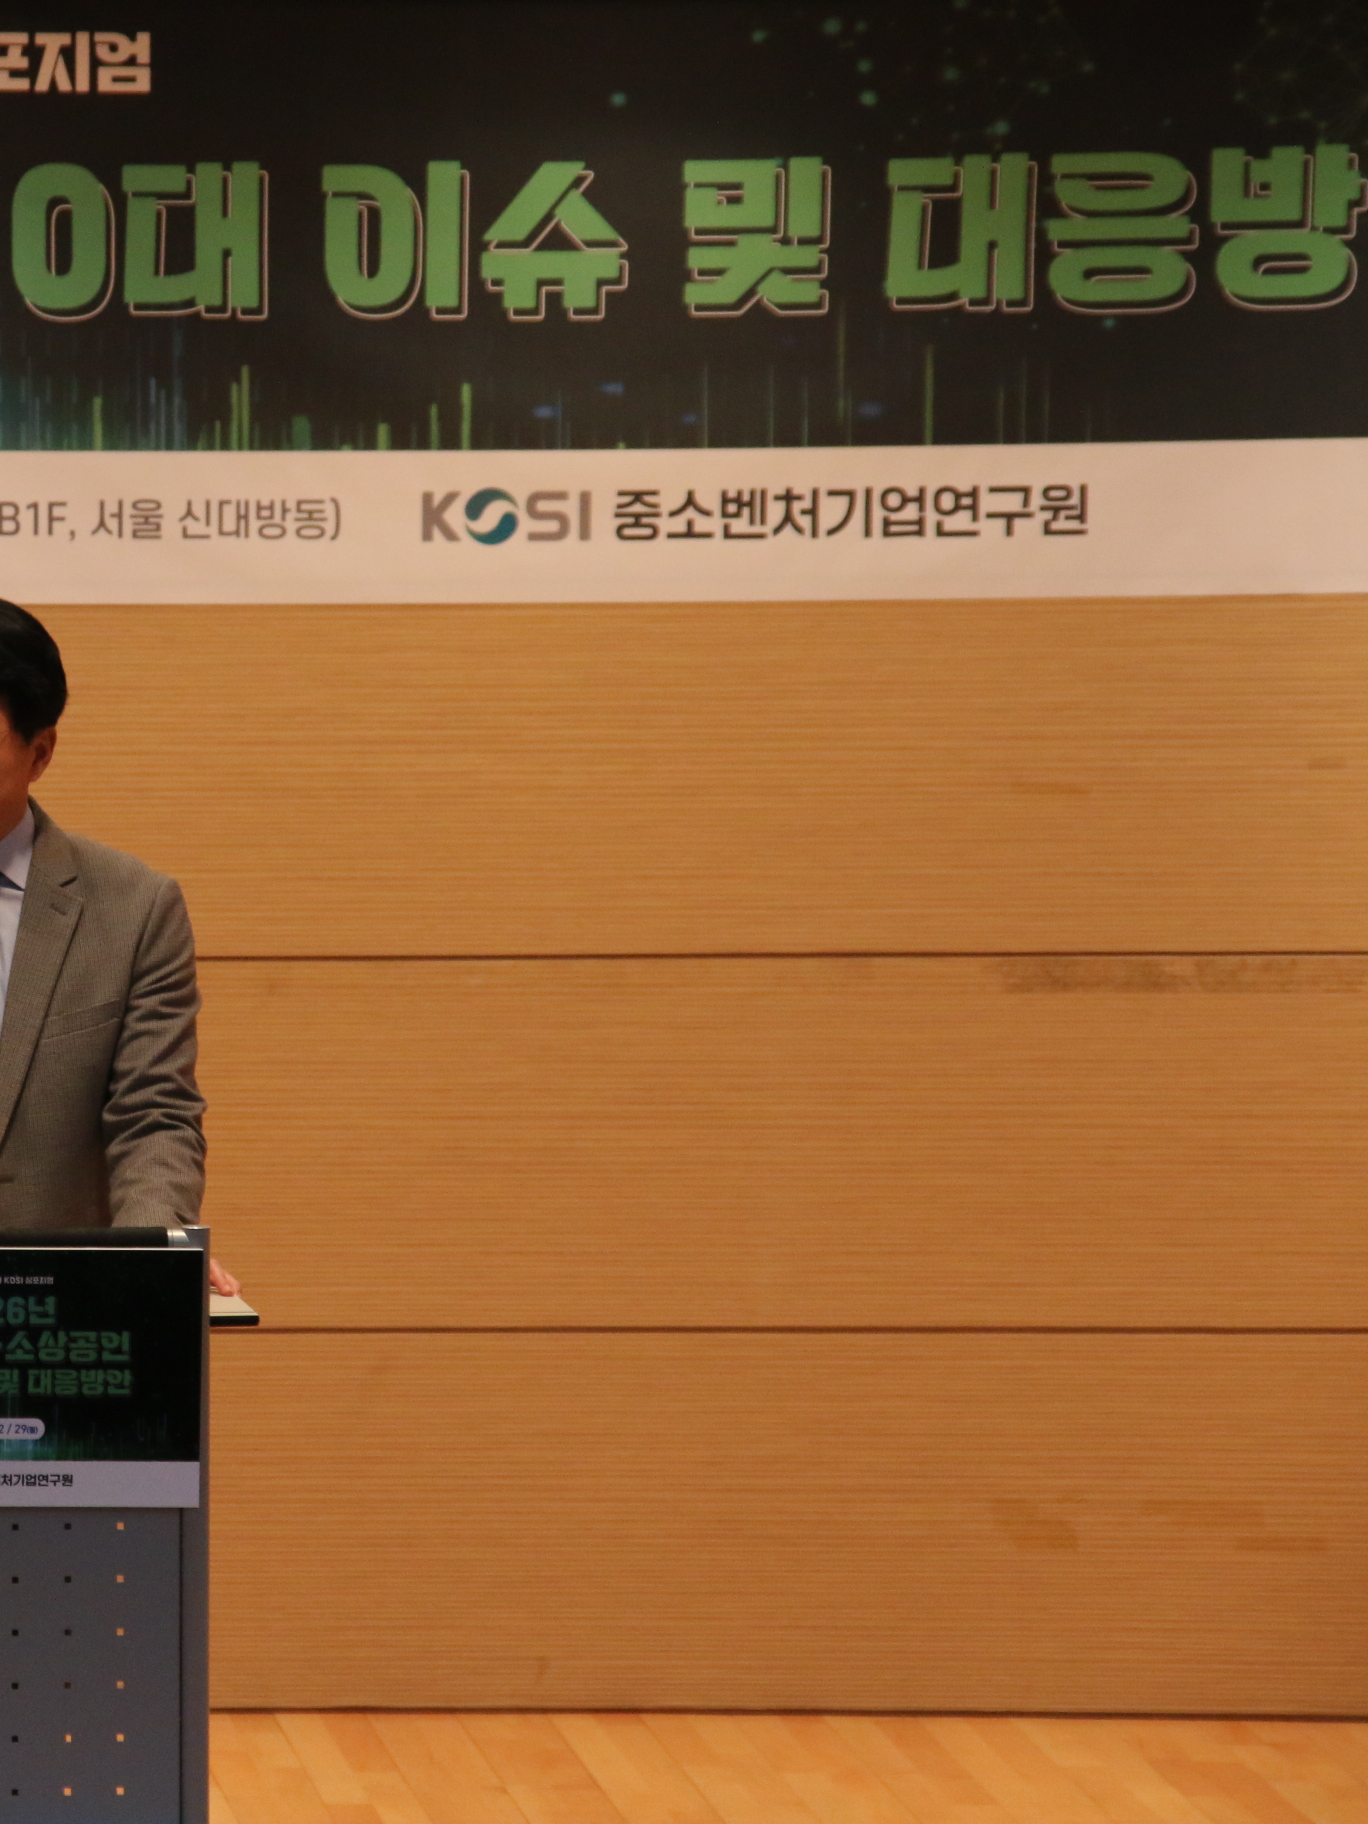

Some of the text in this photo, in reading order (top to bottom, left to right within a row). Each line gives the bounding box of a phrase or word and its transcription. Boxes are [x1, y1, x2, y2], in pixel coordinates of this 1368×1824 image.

[322, 160, 628, 321] 이슈
[683, 157, 830, 317] 및
[91, 499, 164, 540] 서울
[179, 498, 342, 541] 신대방동)
[421, 483, 1089, 546] KOSI 중소벤처기업연구원
[27, 1368, 134, 1397] 대응방안
